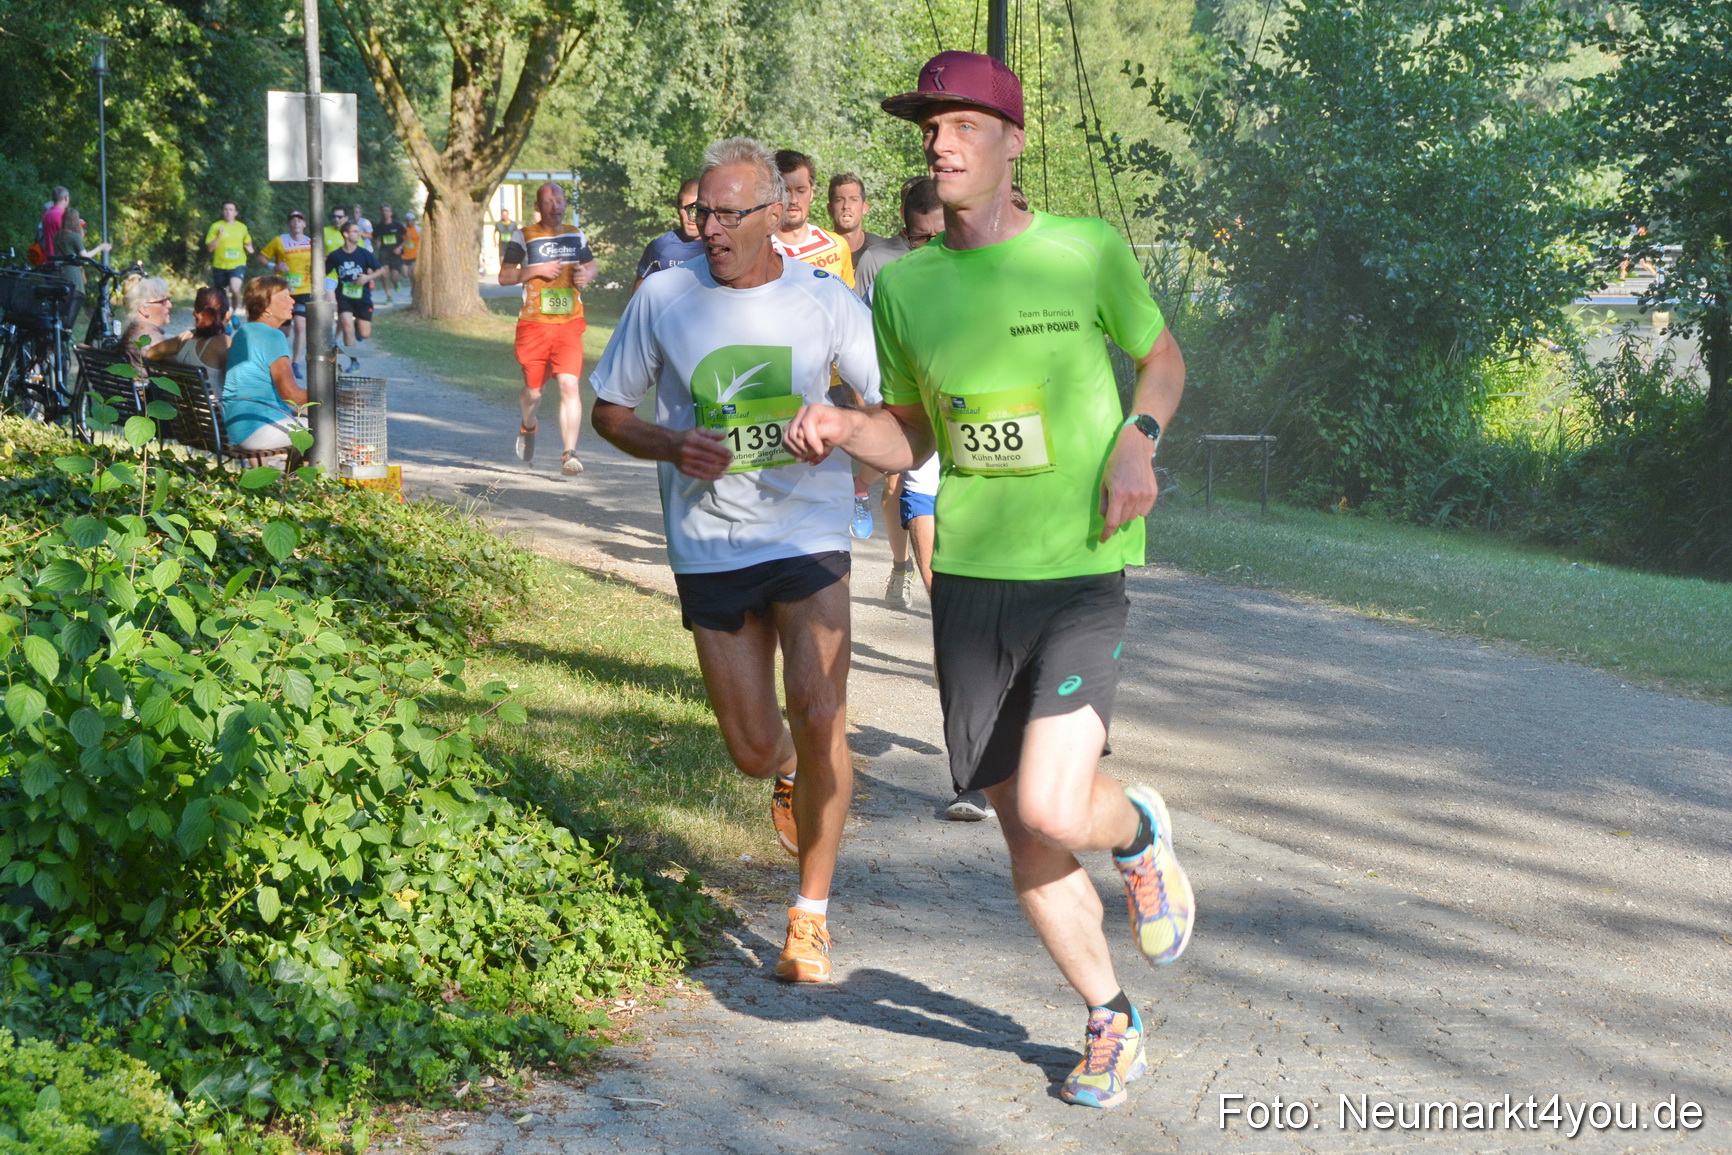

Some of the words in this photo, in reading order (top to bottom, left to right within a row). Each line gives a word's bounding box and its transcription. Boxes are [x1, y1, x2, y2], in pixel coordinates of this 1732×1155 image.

[546, 244, 576, 255] Fischer
[548, 297, 568, 307] 598
[1018, 310, 1040, 318] Team
[1009, 323, 1045, 337] SMART
[1046, 321, 1080, 333] POWER
[728, 423, 782, 451] 139
[960, 421, 1023, 452] 338
[733, 452, 756, 460] ubner
[757, 448, 787, 459] Siegfrie
[971, 453, 993, 461] Kühn
[994, 453, 1021, 461] Marco
